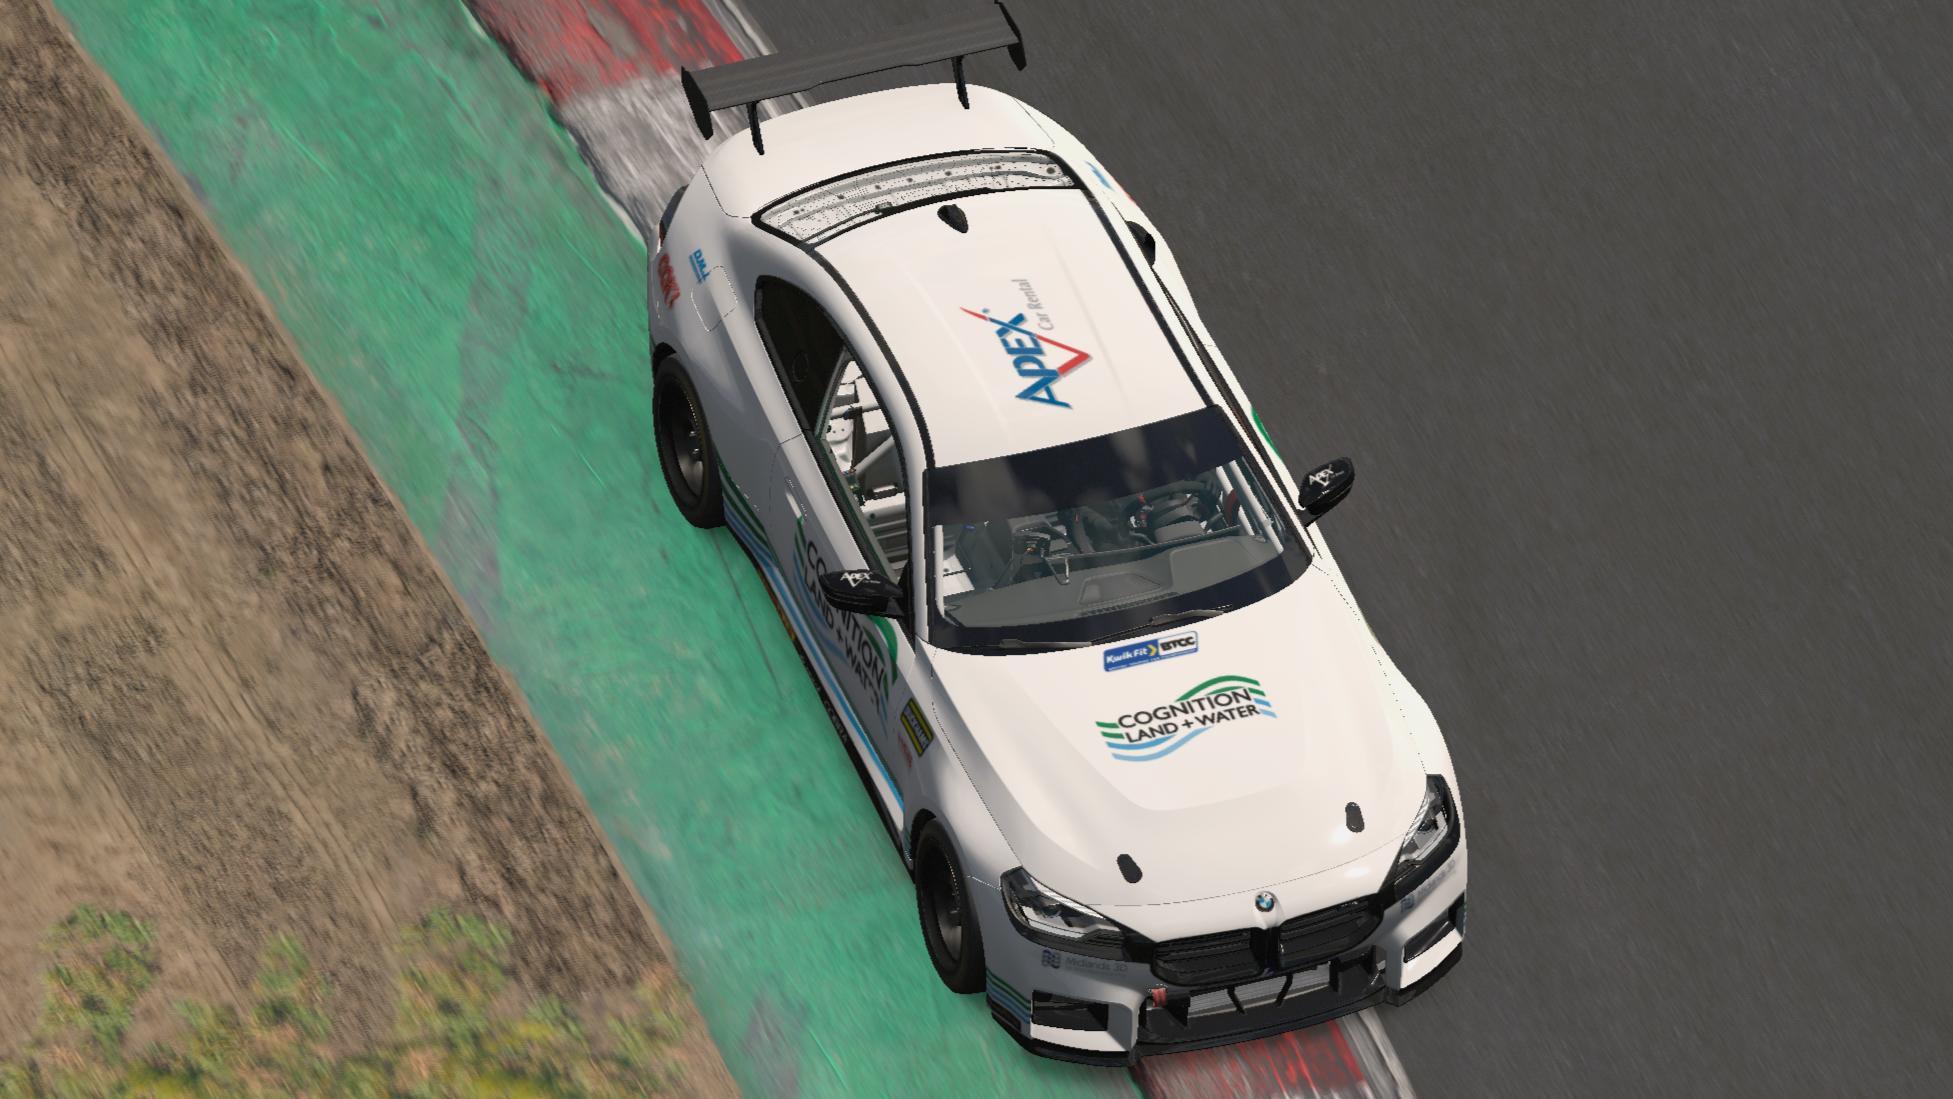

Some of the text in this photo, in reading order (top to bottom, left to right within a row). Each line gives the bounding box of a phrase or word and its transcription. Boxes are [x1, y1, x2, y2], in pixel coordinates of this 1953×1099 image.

[1011, 279, 1054, 331] Car Rental
[988, 313, 1073, 409] APEX
[807, 540, 884, 691] COITION
[1106, 651, 1133, 664] Kwik
[1133, 647, 1148, 658] Fit
[1160, 636, 1195, 651] BTCC
[1117, 688, 1253, 729] COGNITION
[1125, 722, 1179, 743] LAND
[1194, 704, 1261, 726] WATER
